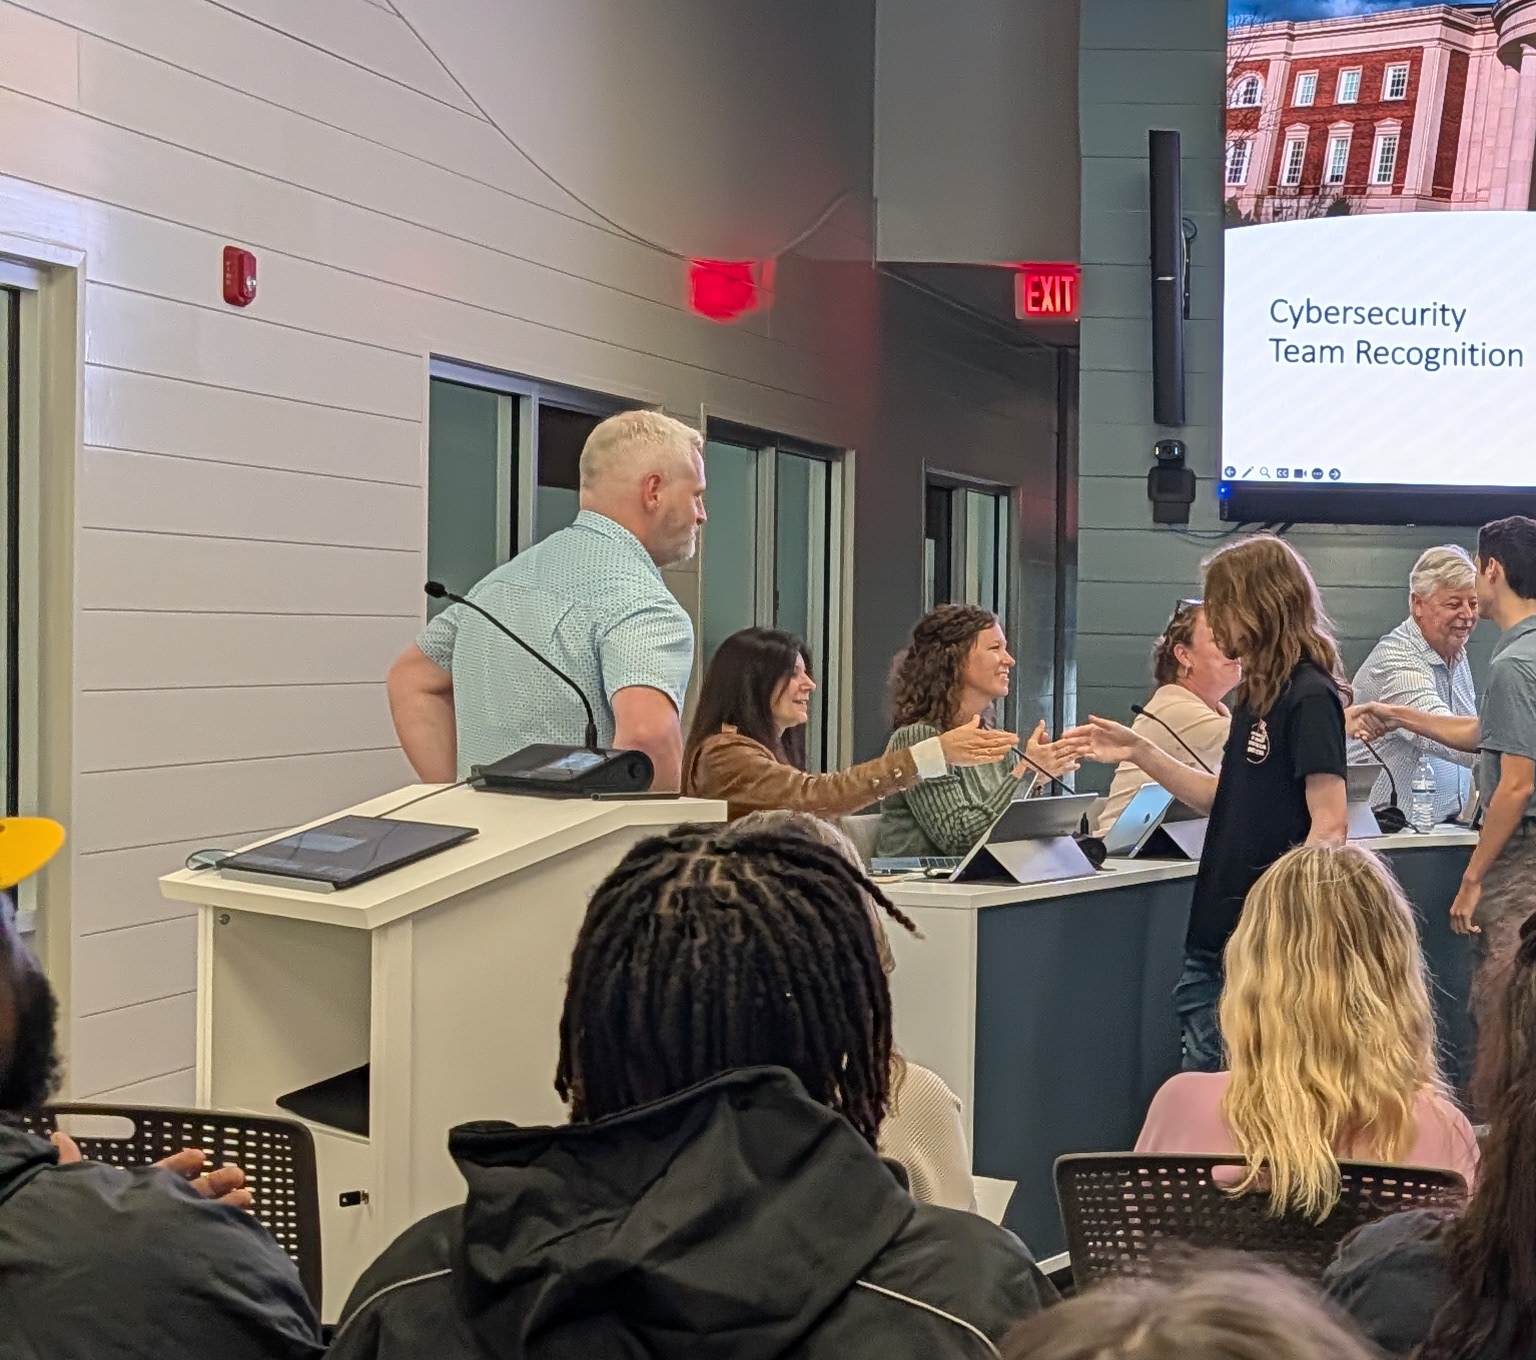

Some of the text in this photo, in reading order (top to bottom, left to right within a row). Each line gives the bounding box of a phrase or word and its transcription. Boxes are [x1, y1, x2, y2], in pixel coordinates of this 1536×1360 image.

[1026, 275, 1074, 314] EXIT
[1269, 297, 1467, 334] Cybersecurity
[1268, 337, 1524, 373] Team Recognition
